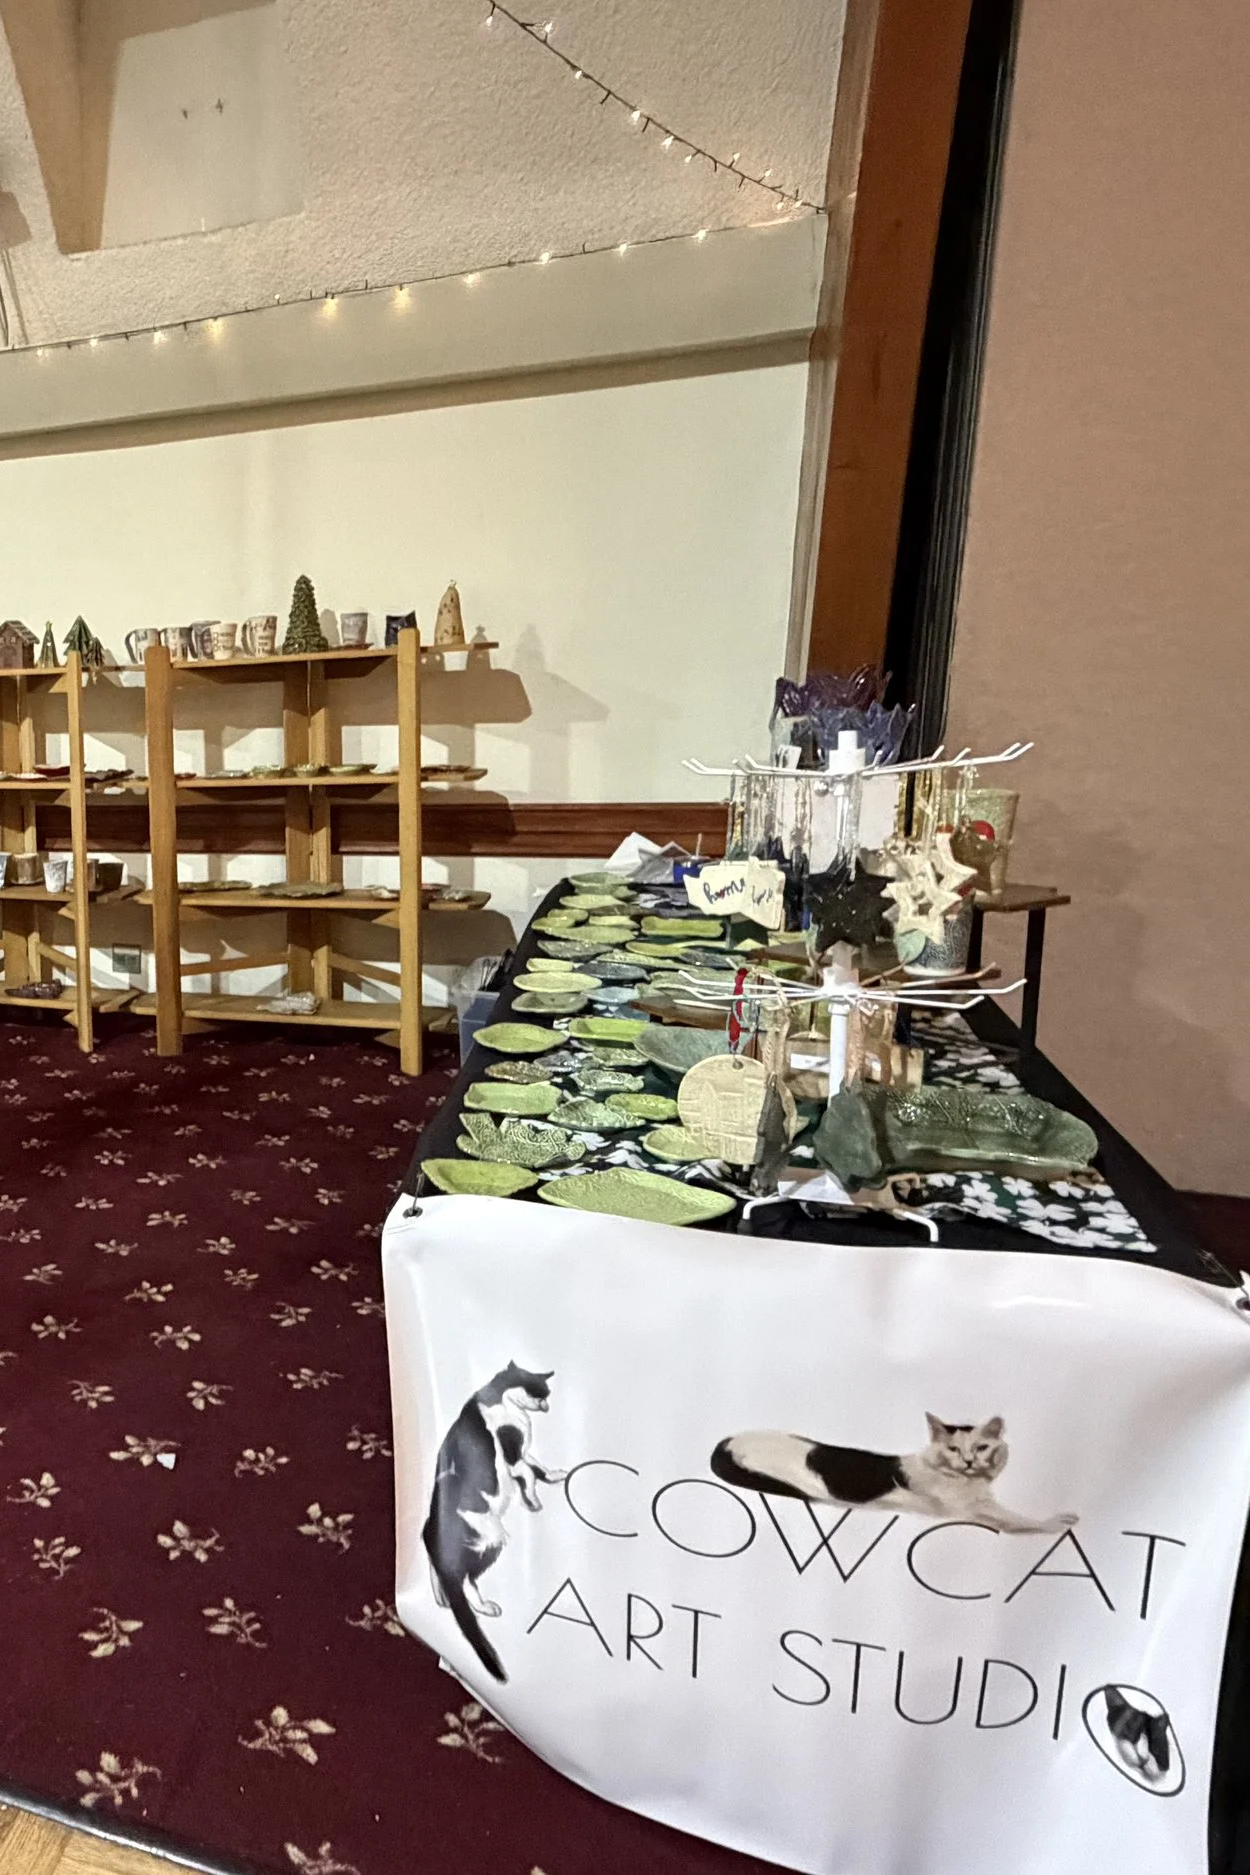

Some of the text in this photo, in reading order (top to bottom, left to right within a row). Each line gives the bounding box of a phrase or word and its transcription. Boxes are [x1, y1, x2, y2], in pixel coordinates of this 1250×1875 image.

[565, 1460, 1186, 1620] COWCAT
[527, 1577, 1186, 1797] ART STUDIO
